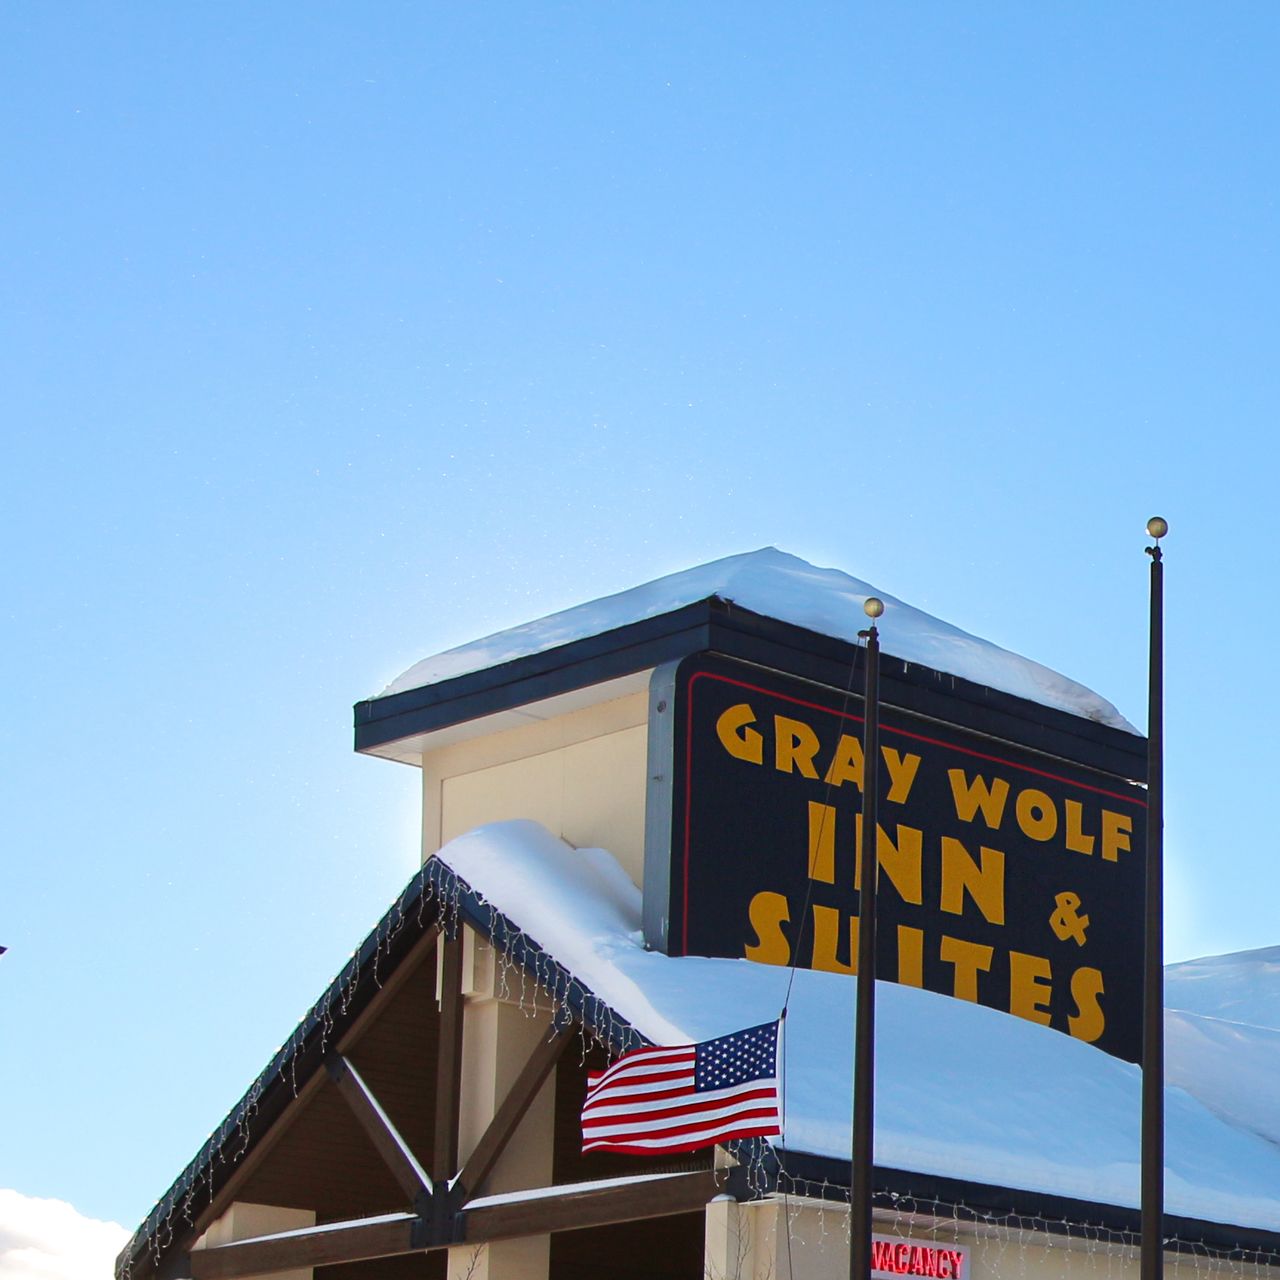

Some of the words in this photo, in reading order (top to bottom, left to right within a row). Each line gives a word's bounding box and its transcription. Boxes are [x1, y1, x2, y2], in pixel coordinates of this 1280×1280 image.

[716, 704, 921, 804] GRAY
[948, 769, 1133, 862] WOLF
[808, 801, 1005, 925] INN
[1049, 891, 1090, 947] &
[744, 891, 1105, 1043] SUITES
[871, 1241, 963, 1279] VACANCY
